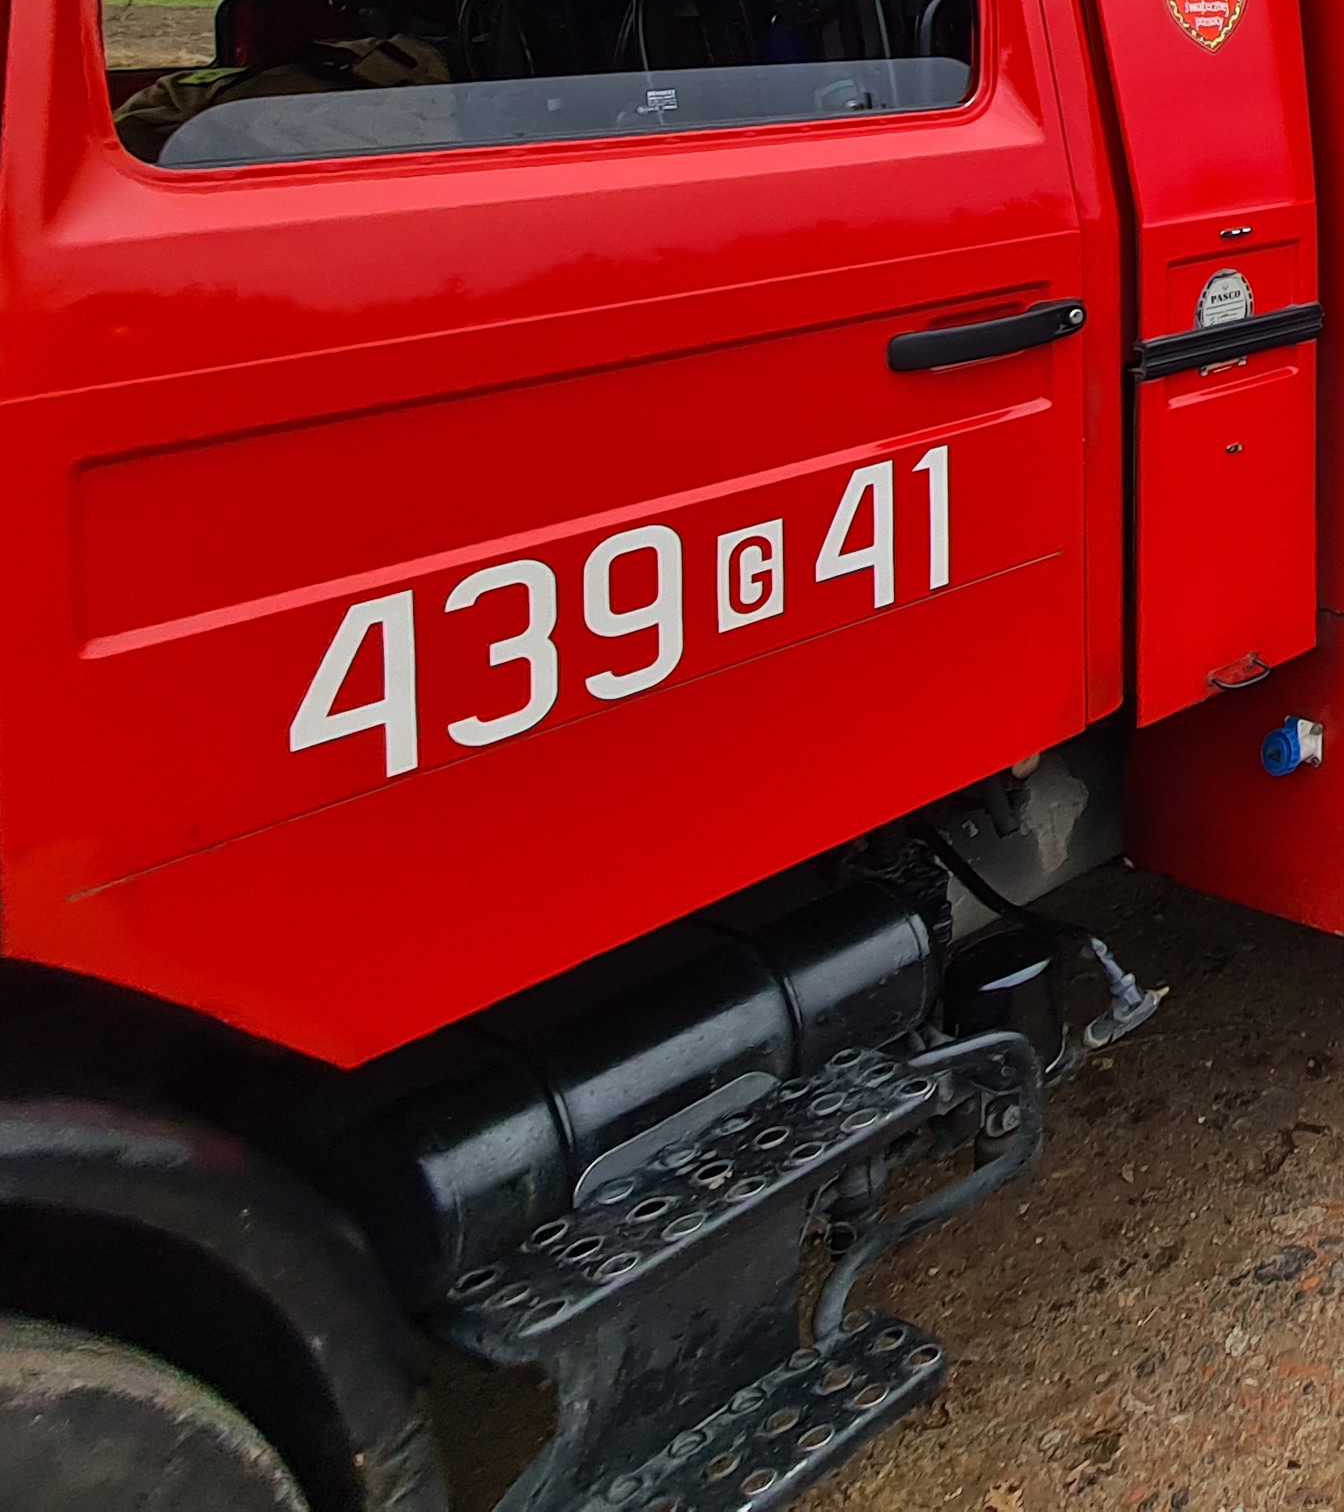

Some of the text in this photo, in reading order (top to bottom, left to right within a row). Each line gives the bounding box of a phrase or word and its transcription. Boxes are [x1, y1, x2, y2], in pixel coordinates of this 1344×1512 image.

[1210, 290, 1241, 304] PASCO
[290, 444, 950, 778] 439 G 41
